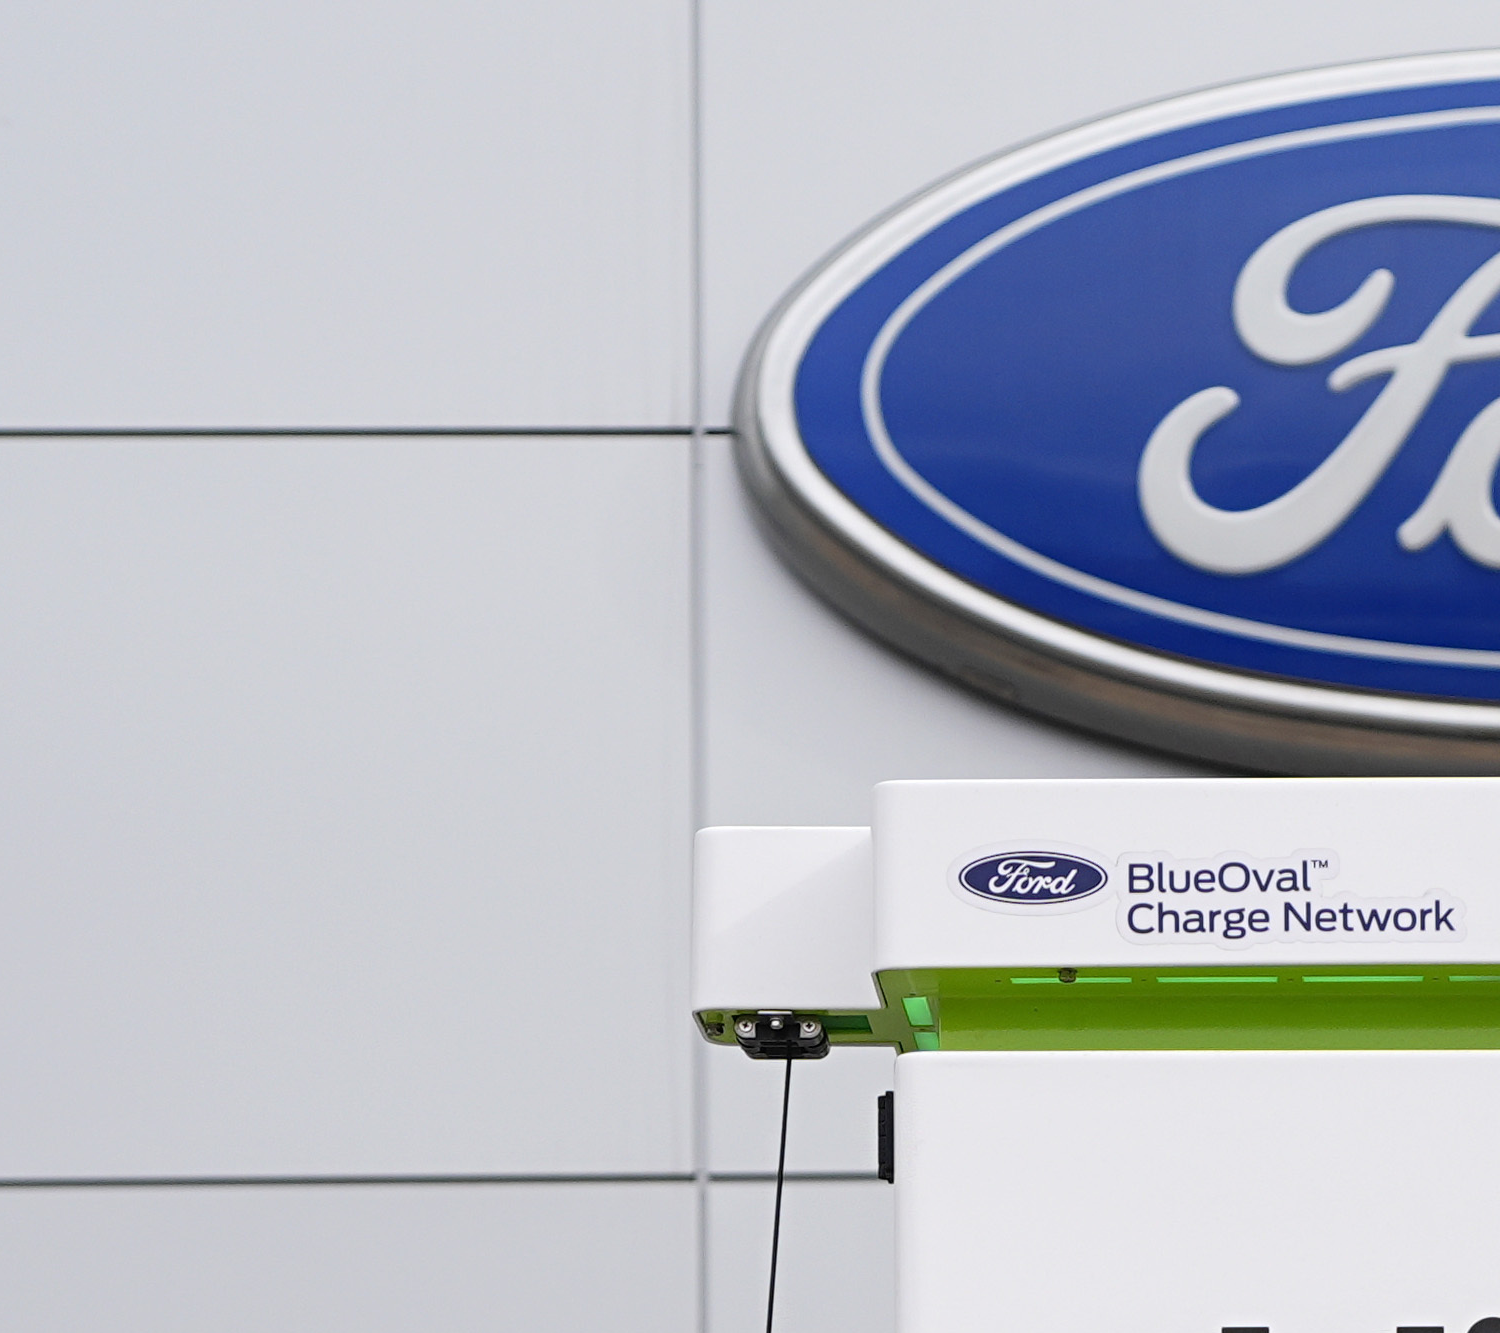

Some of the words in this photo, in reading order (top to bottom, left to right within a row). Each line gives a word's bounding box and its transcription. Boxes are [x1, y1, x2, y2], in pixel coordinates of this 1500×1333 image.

[987, 857, 1078, 896] Ford
[1127, 901, 1271, 939] Charge
[1283, 899, 1455, 932] Network
